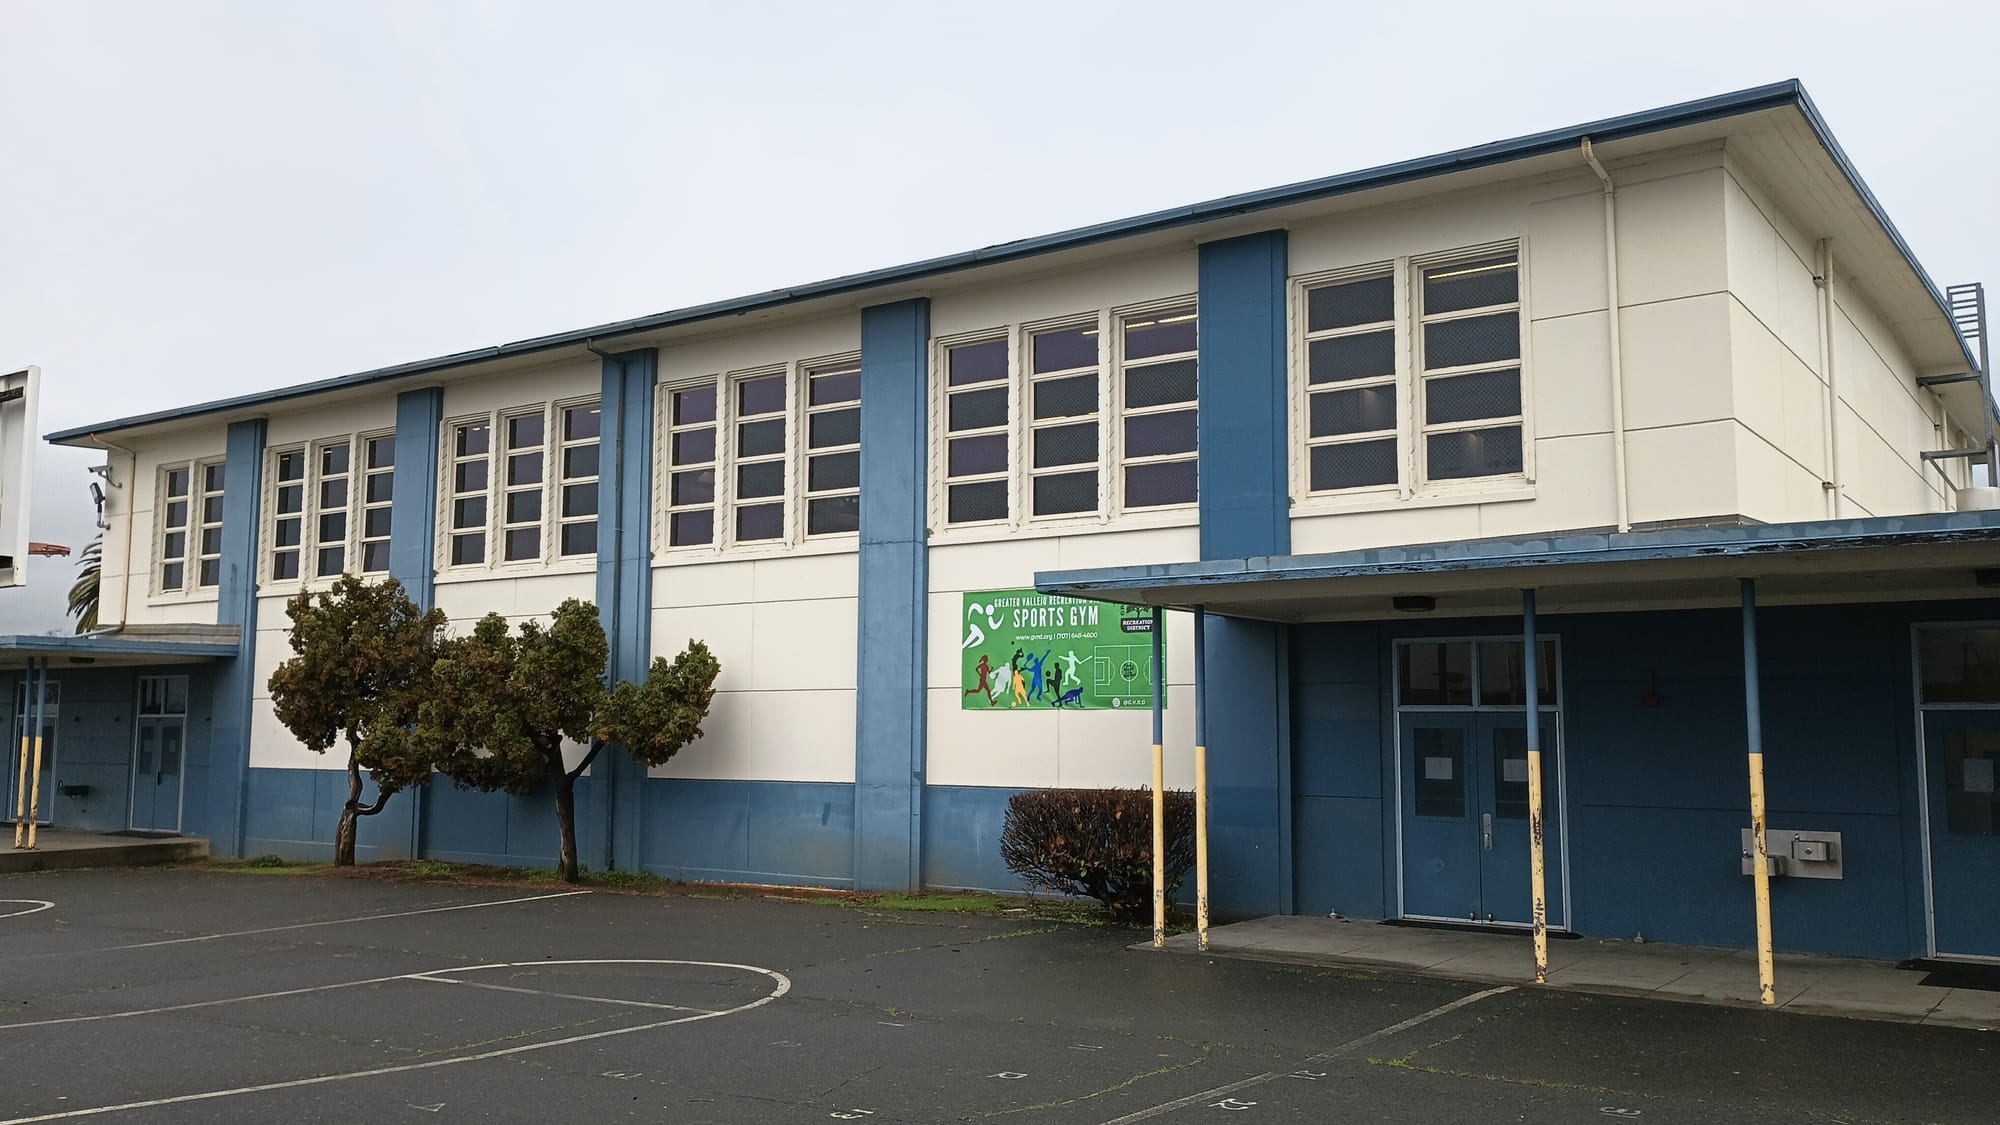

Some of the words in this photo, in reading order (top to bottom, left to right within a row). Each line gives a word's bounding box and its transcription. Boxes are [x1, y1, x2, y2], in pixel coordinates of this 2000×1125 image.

[994, 598, 1020, 608] GREATER
[1022, 596, 1047, 606] VALLEJO
[1013, 607, 1064, 628] SPORTS
[1070, 605, 1099, 626] GYM
